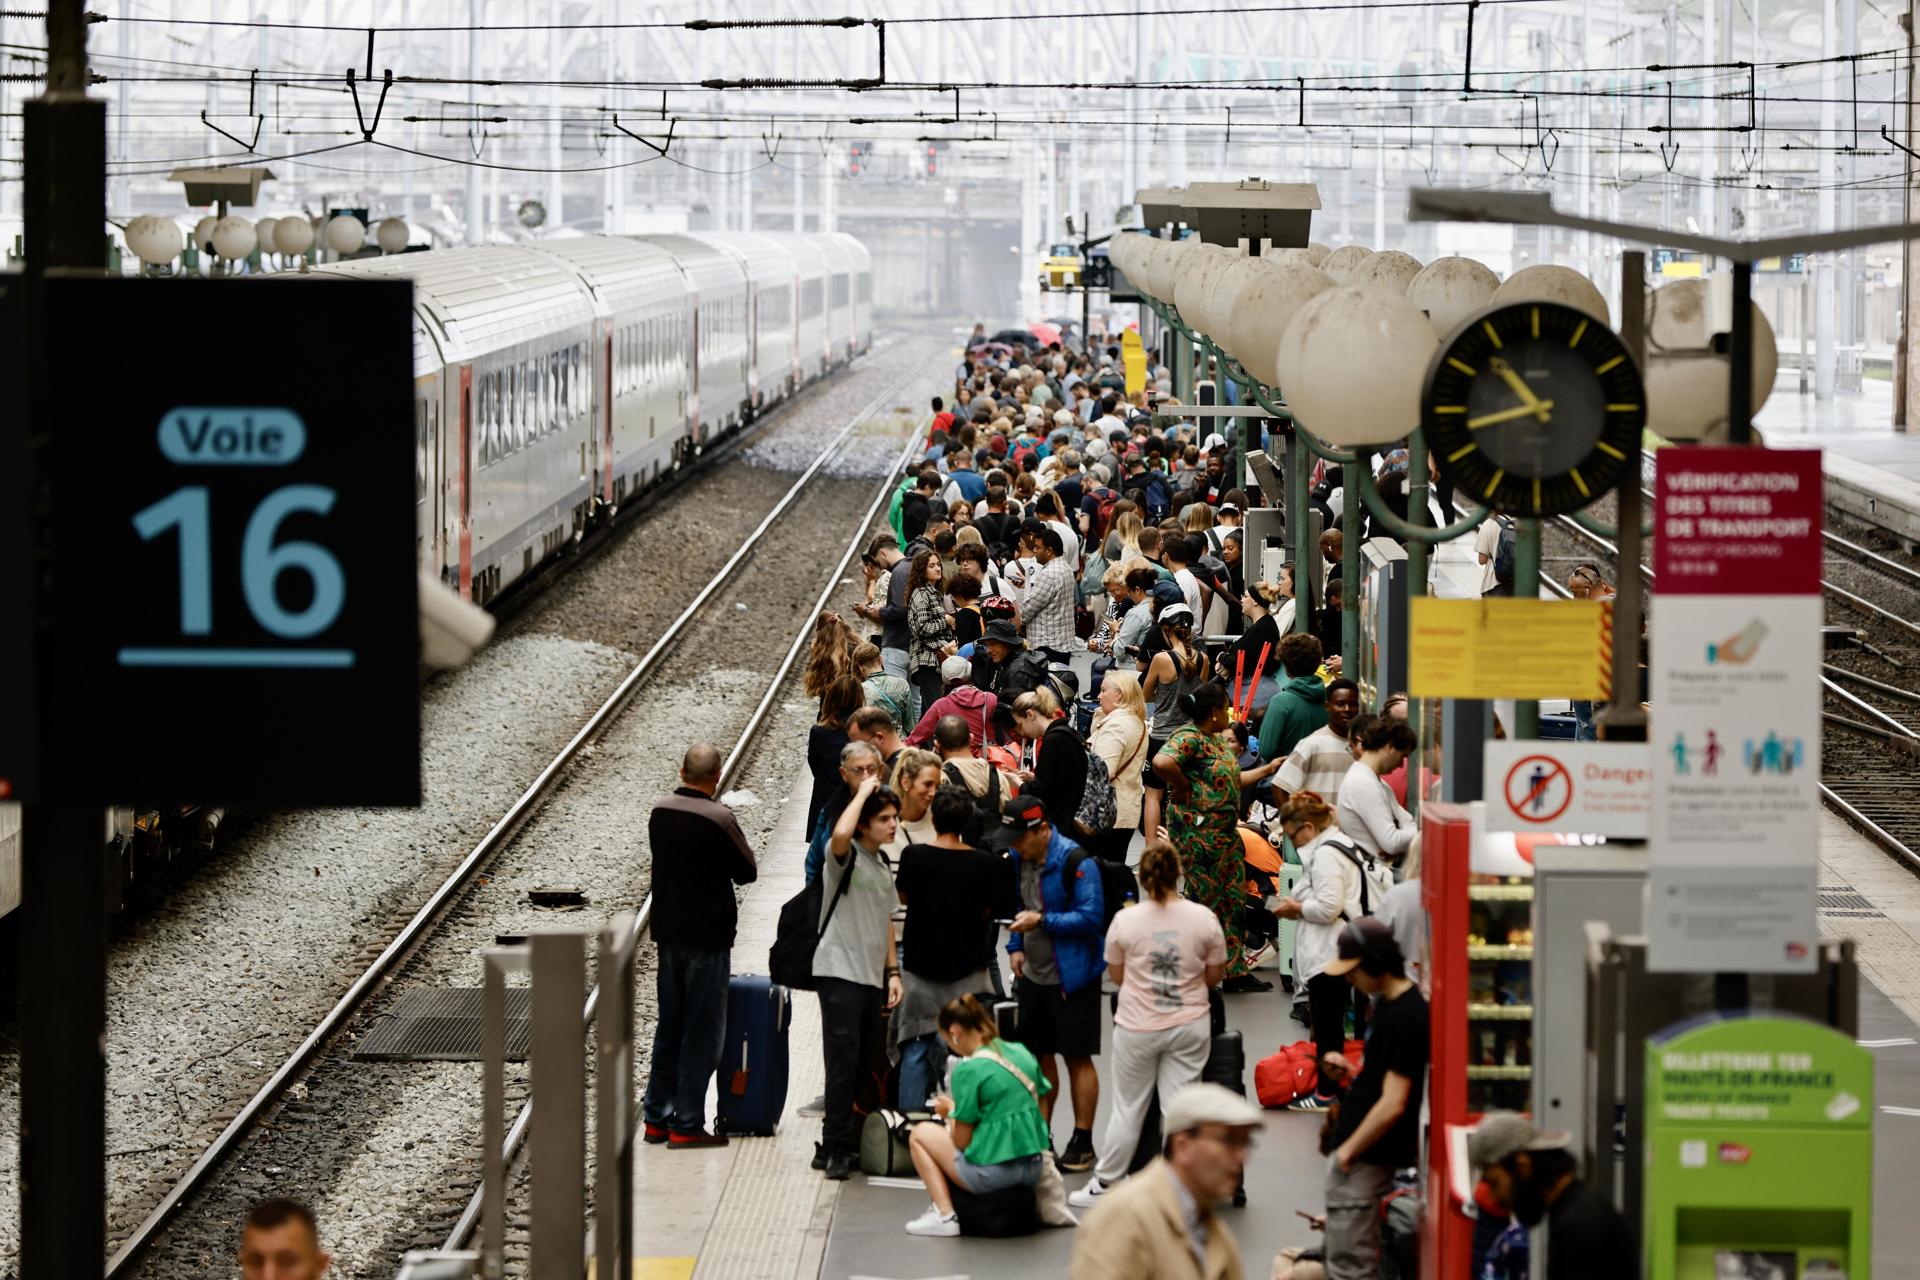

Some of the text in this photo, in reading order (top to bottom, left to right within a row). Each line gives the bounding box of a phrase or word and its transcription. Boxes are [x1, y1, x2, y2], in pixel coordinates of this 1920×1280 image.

[175, 414, 285, 457] Voie
[1665, 496, 1772, 515] DES TITRES
[1665, 518, 1812, 538] DE TRANSPORT
[132, 484, 346, 639] 16
